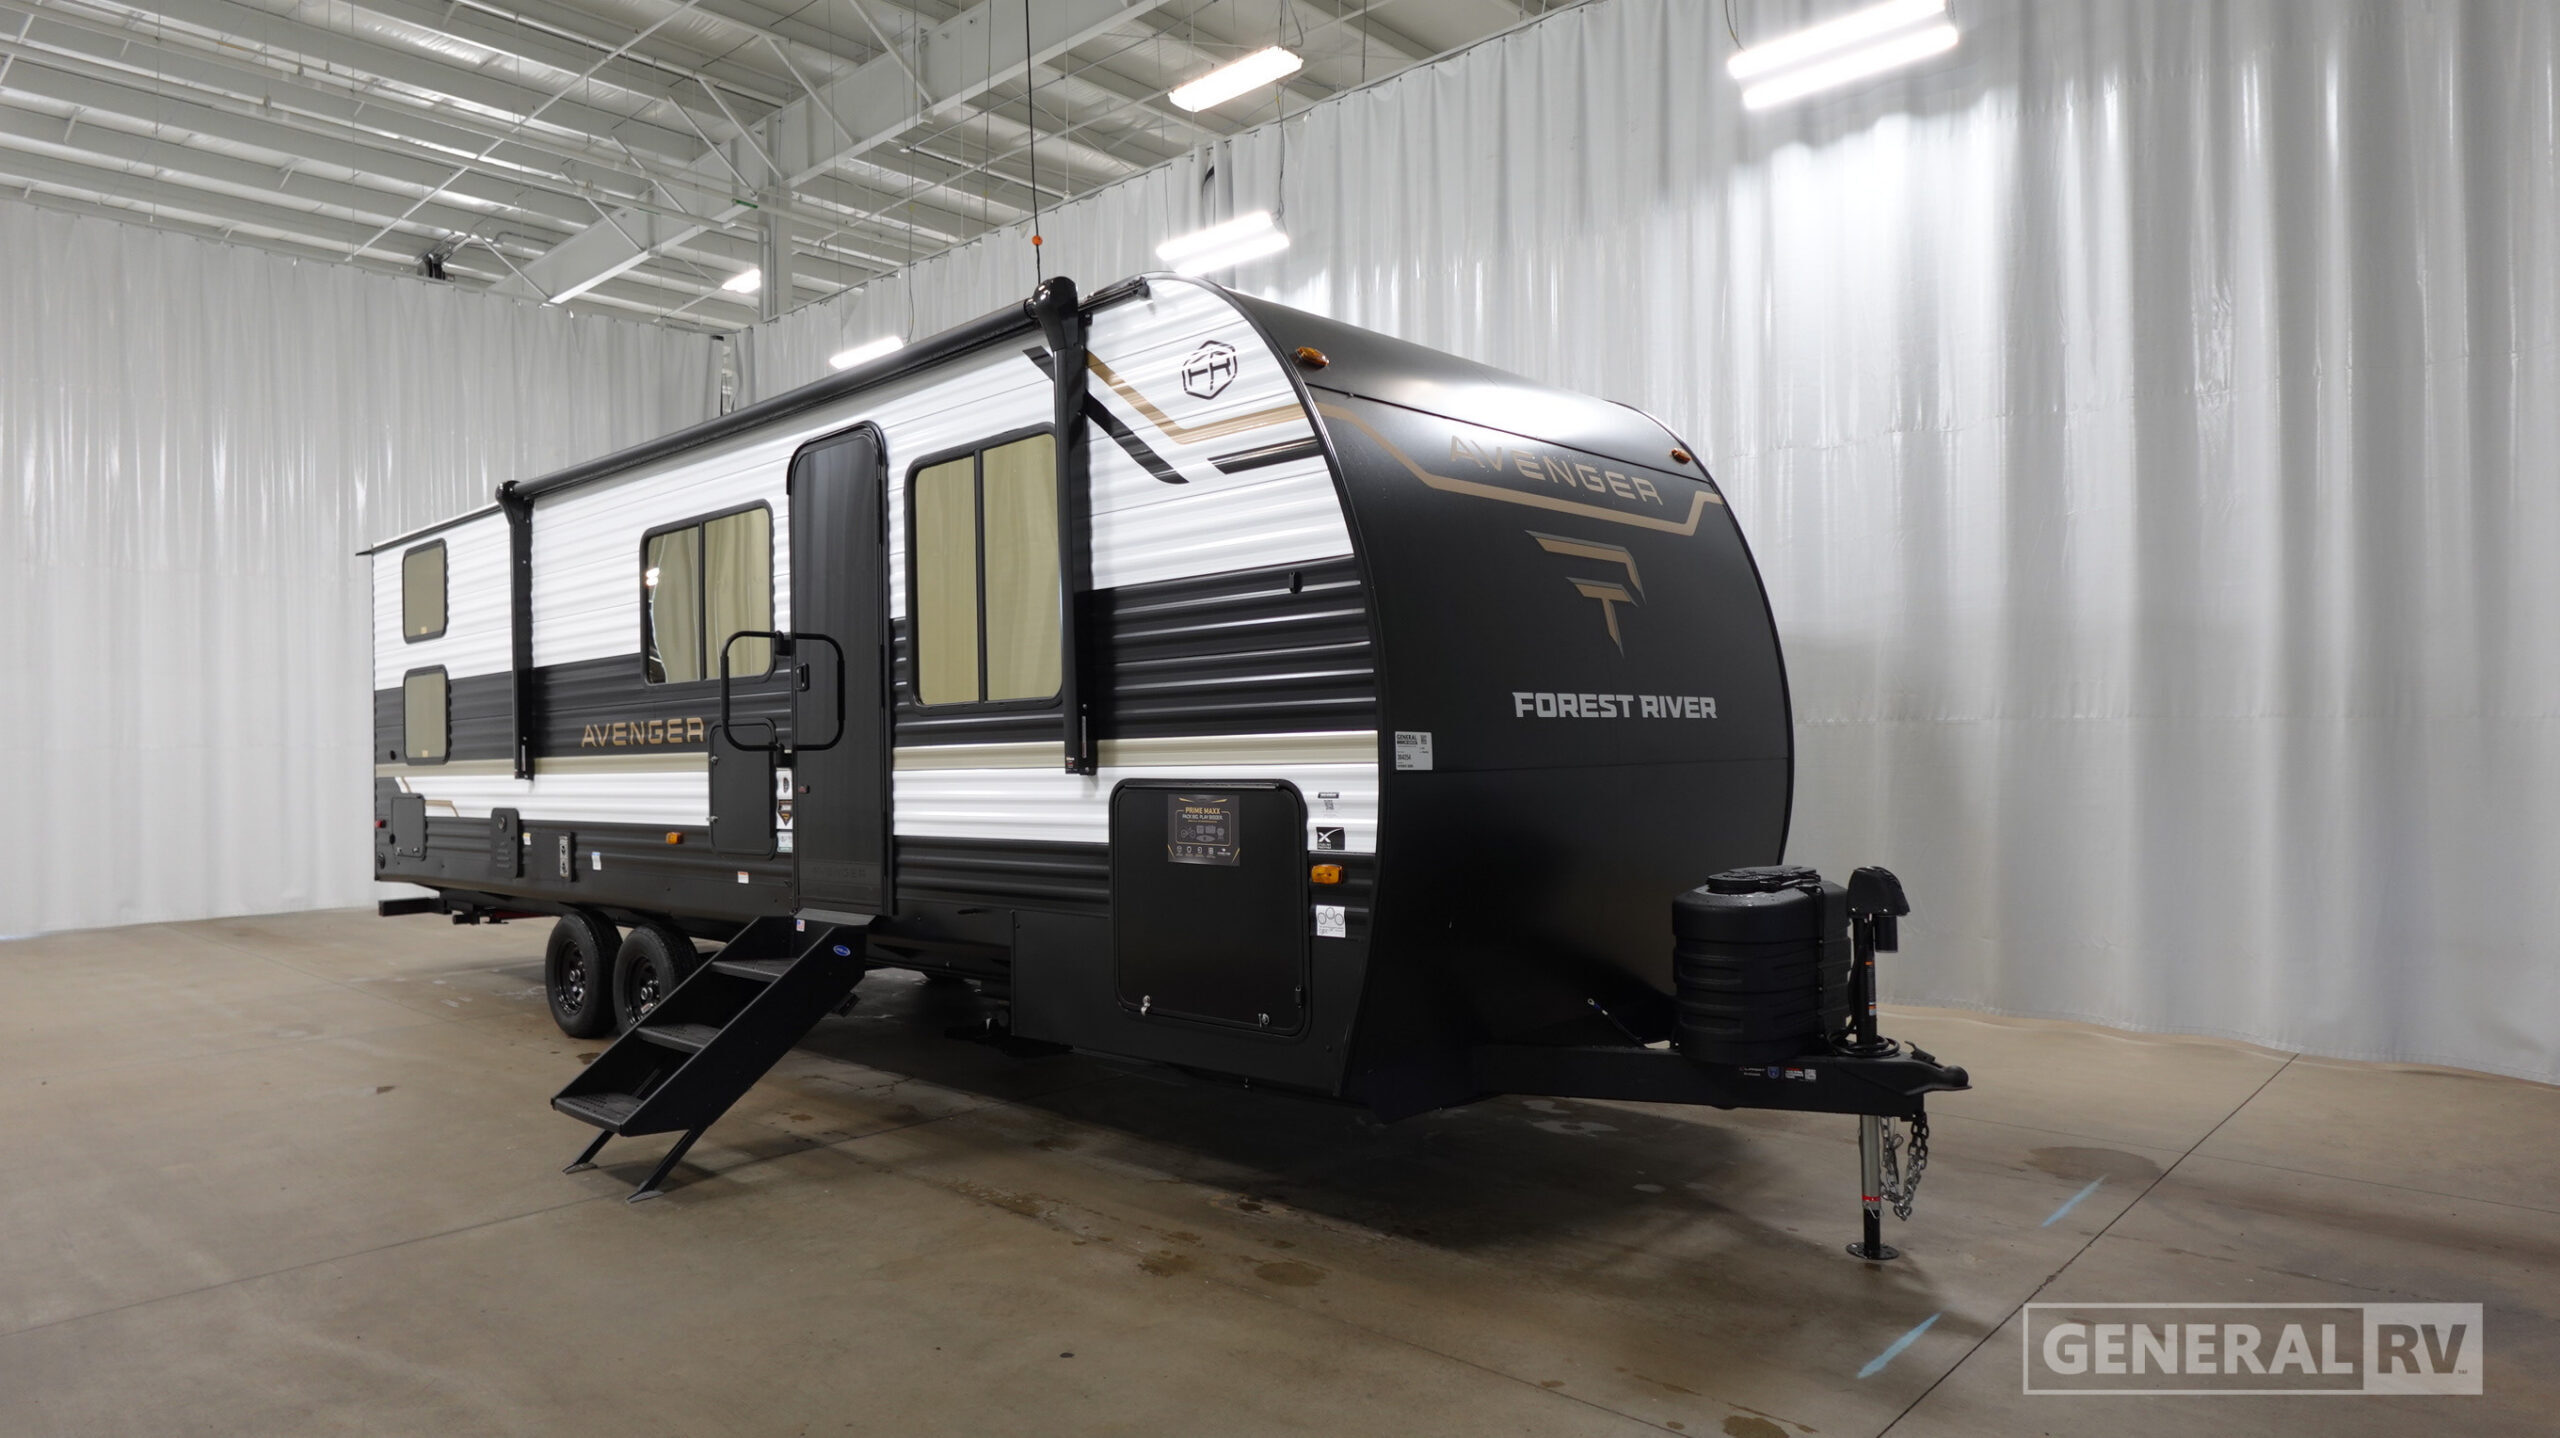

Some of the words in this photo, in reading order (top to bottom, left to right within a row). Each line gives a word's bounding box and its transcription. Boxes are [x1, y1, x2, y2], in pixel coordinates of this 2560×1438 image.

[1451, 435, 1664, 506] AVENGER
[1512, 692, 1634, 718] FOREST
[1638, 694, 1718, 719] RIVER
[581, 717, 704, 748] AVENGER
[1203, 807, 1221, 815] MAXX
